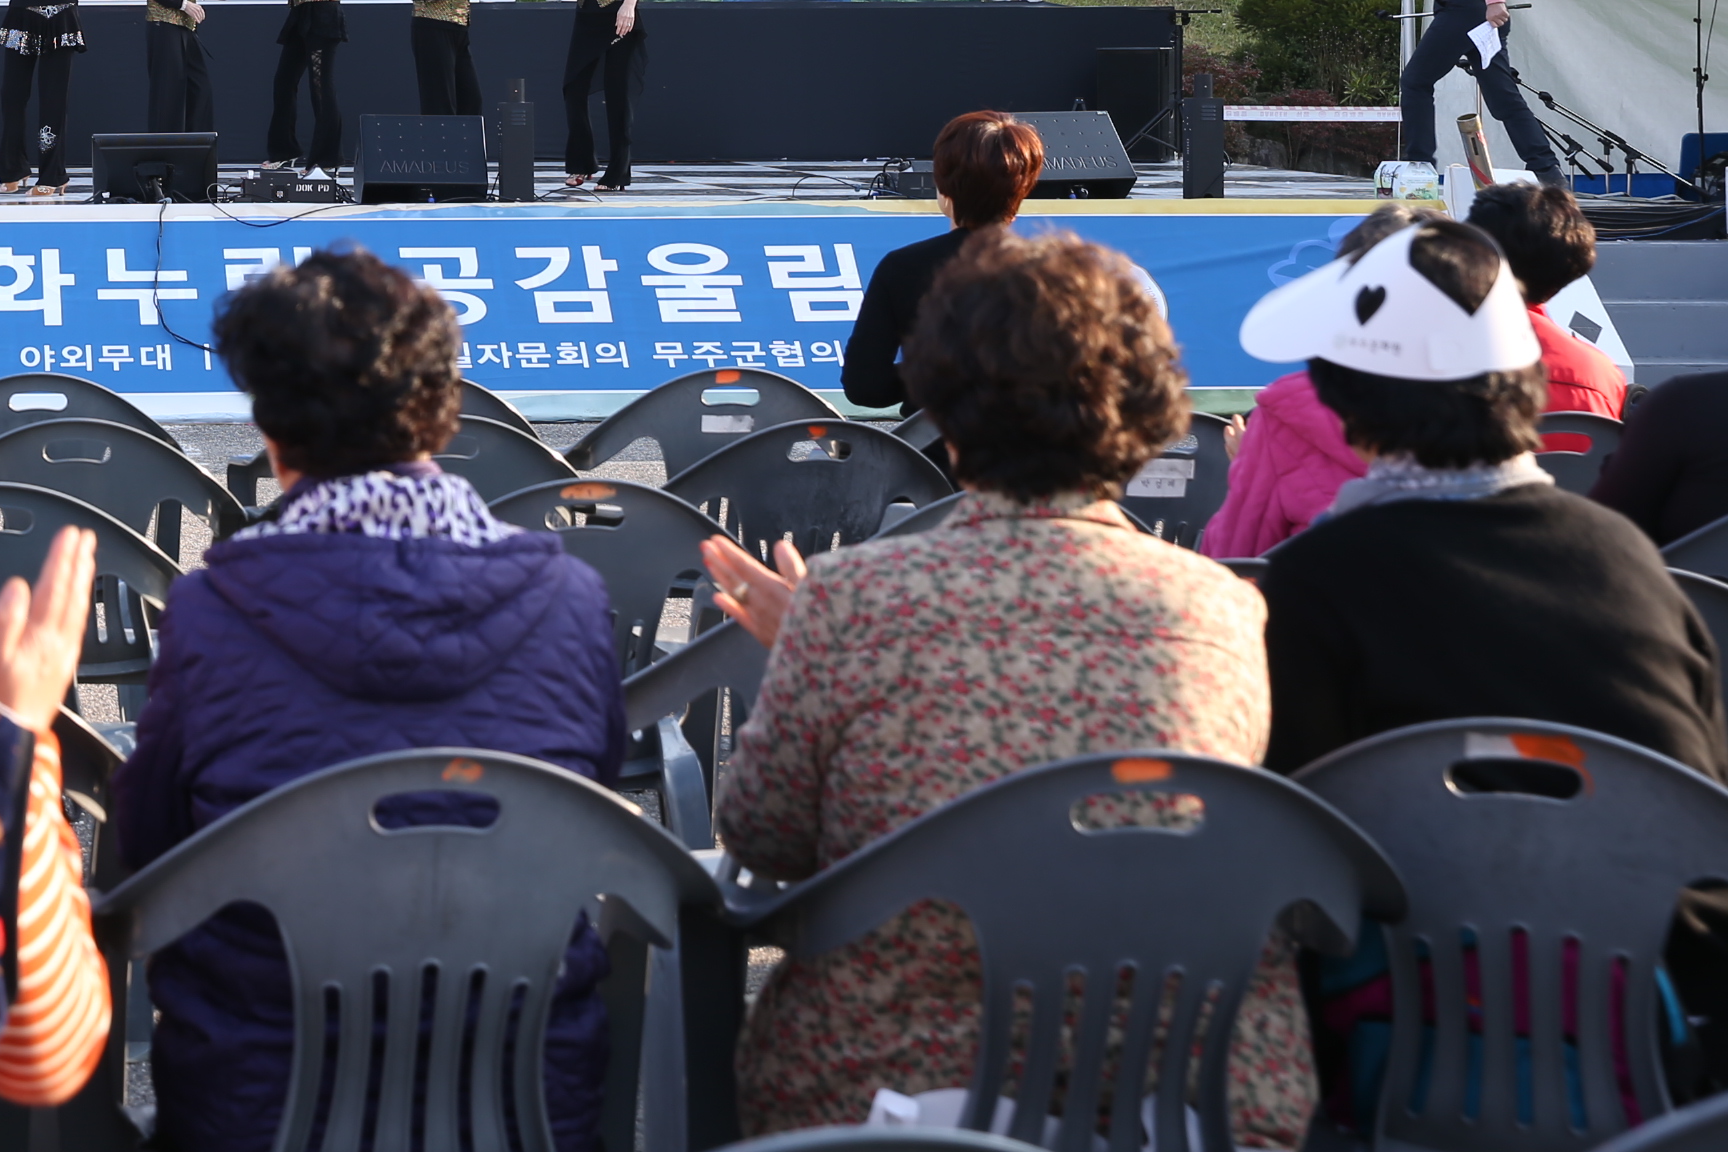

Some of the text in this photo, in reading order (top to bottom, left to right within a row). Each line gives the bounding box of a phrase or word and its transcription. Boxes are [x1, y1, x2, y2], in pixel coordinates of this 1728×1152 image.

[379, 159, 470, 174] AMADEUS
[398, 242, 865, 327] 공감울림
[18, 343, 173, 372] 야외무대
